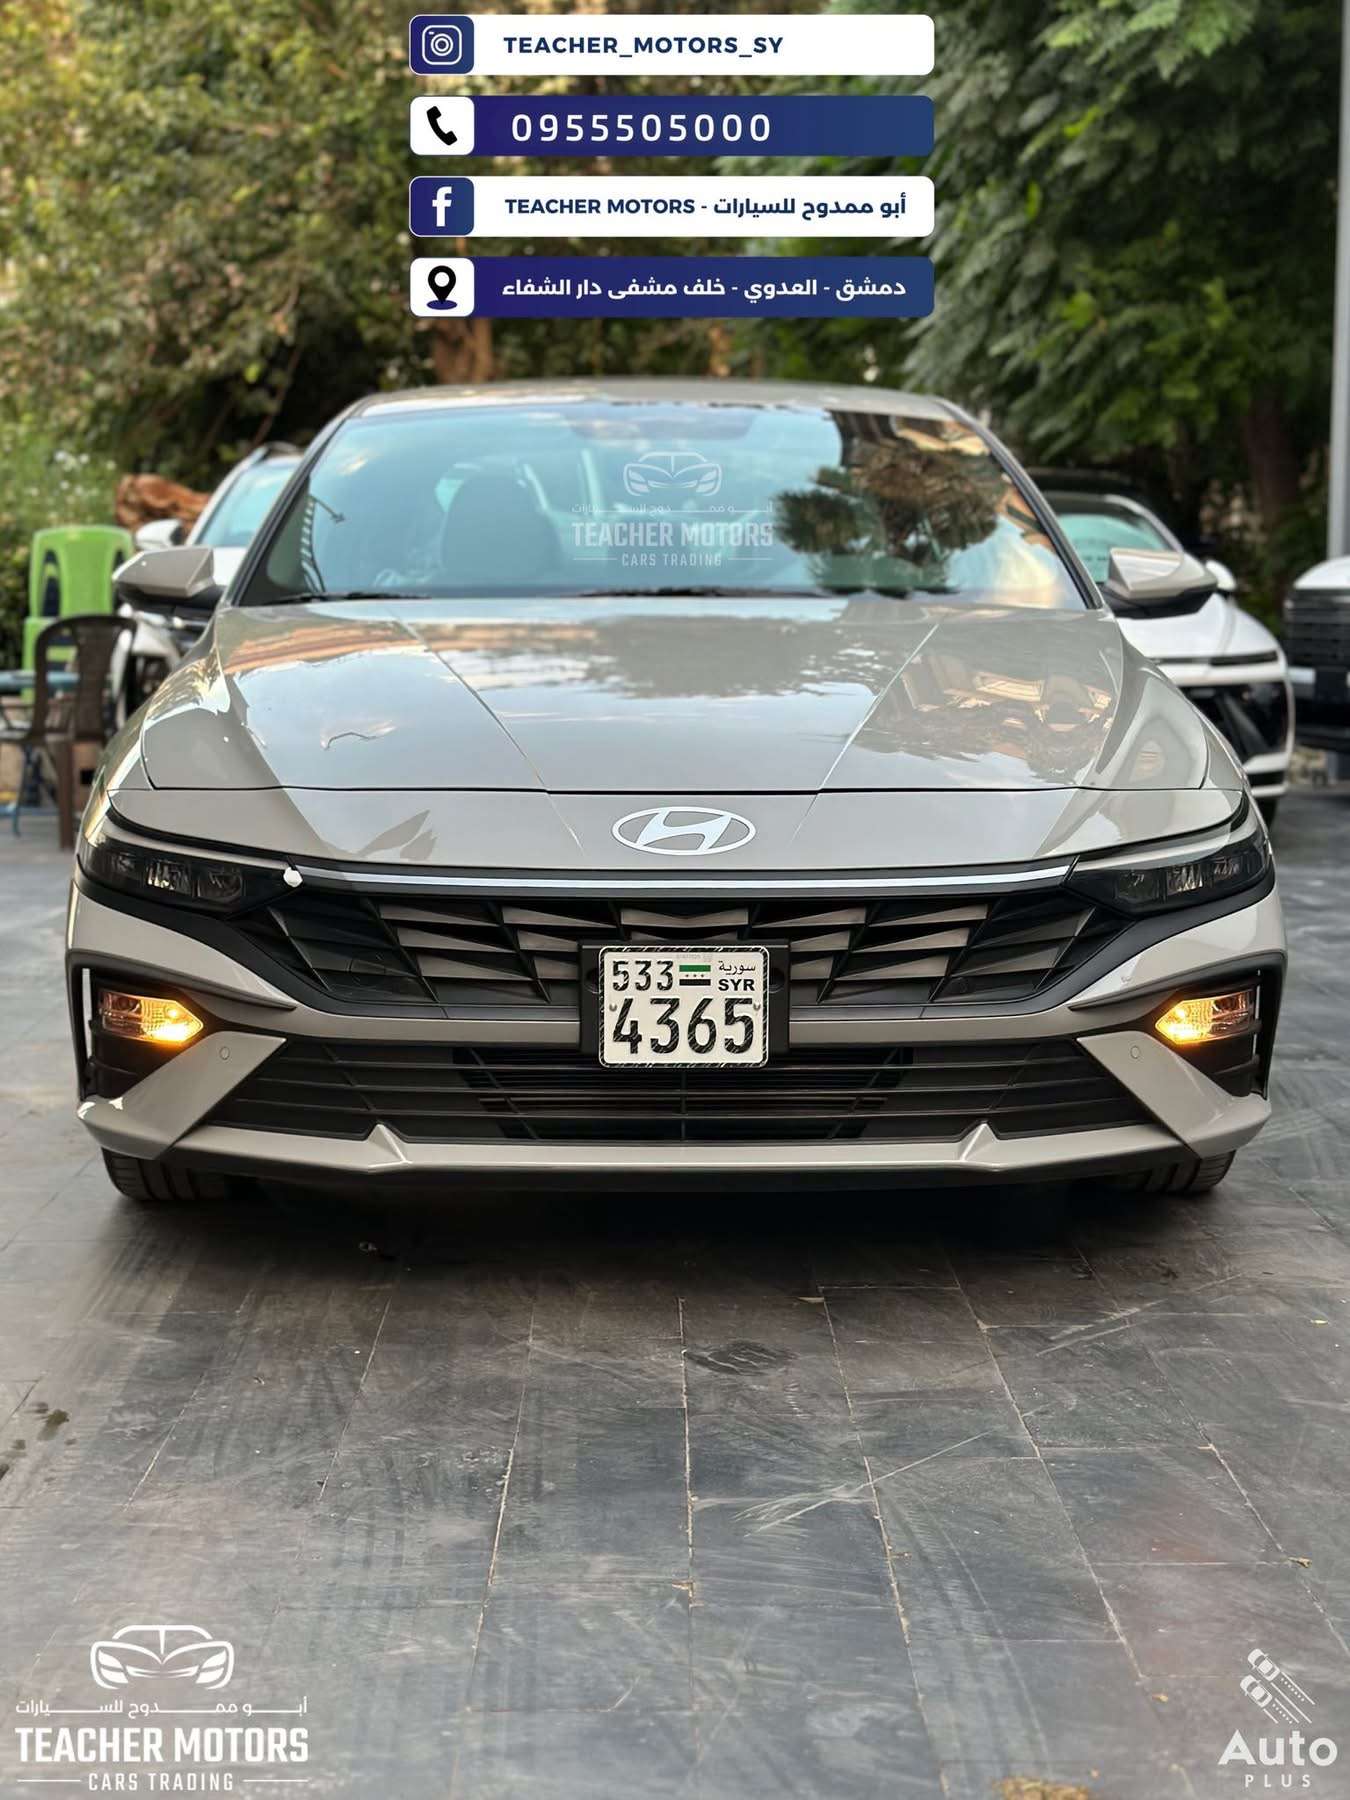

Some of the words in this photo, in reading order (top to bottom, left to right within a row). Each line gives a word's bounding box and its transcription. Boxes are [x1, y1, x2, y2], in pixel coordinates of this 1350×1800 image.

[612, 960, 674, 991] 533
[718, 960, 756, 975] سورية
[718, 979, 755, 991] SYR
[613, 998, 754, 1054] 4365
